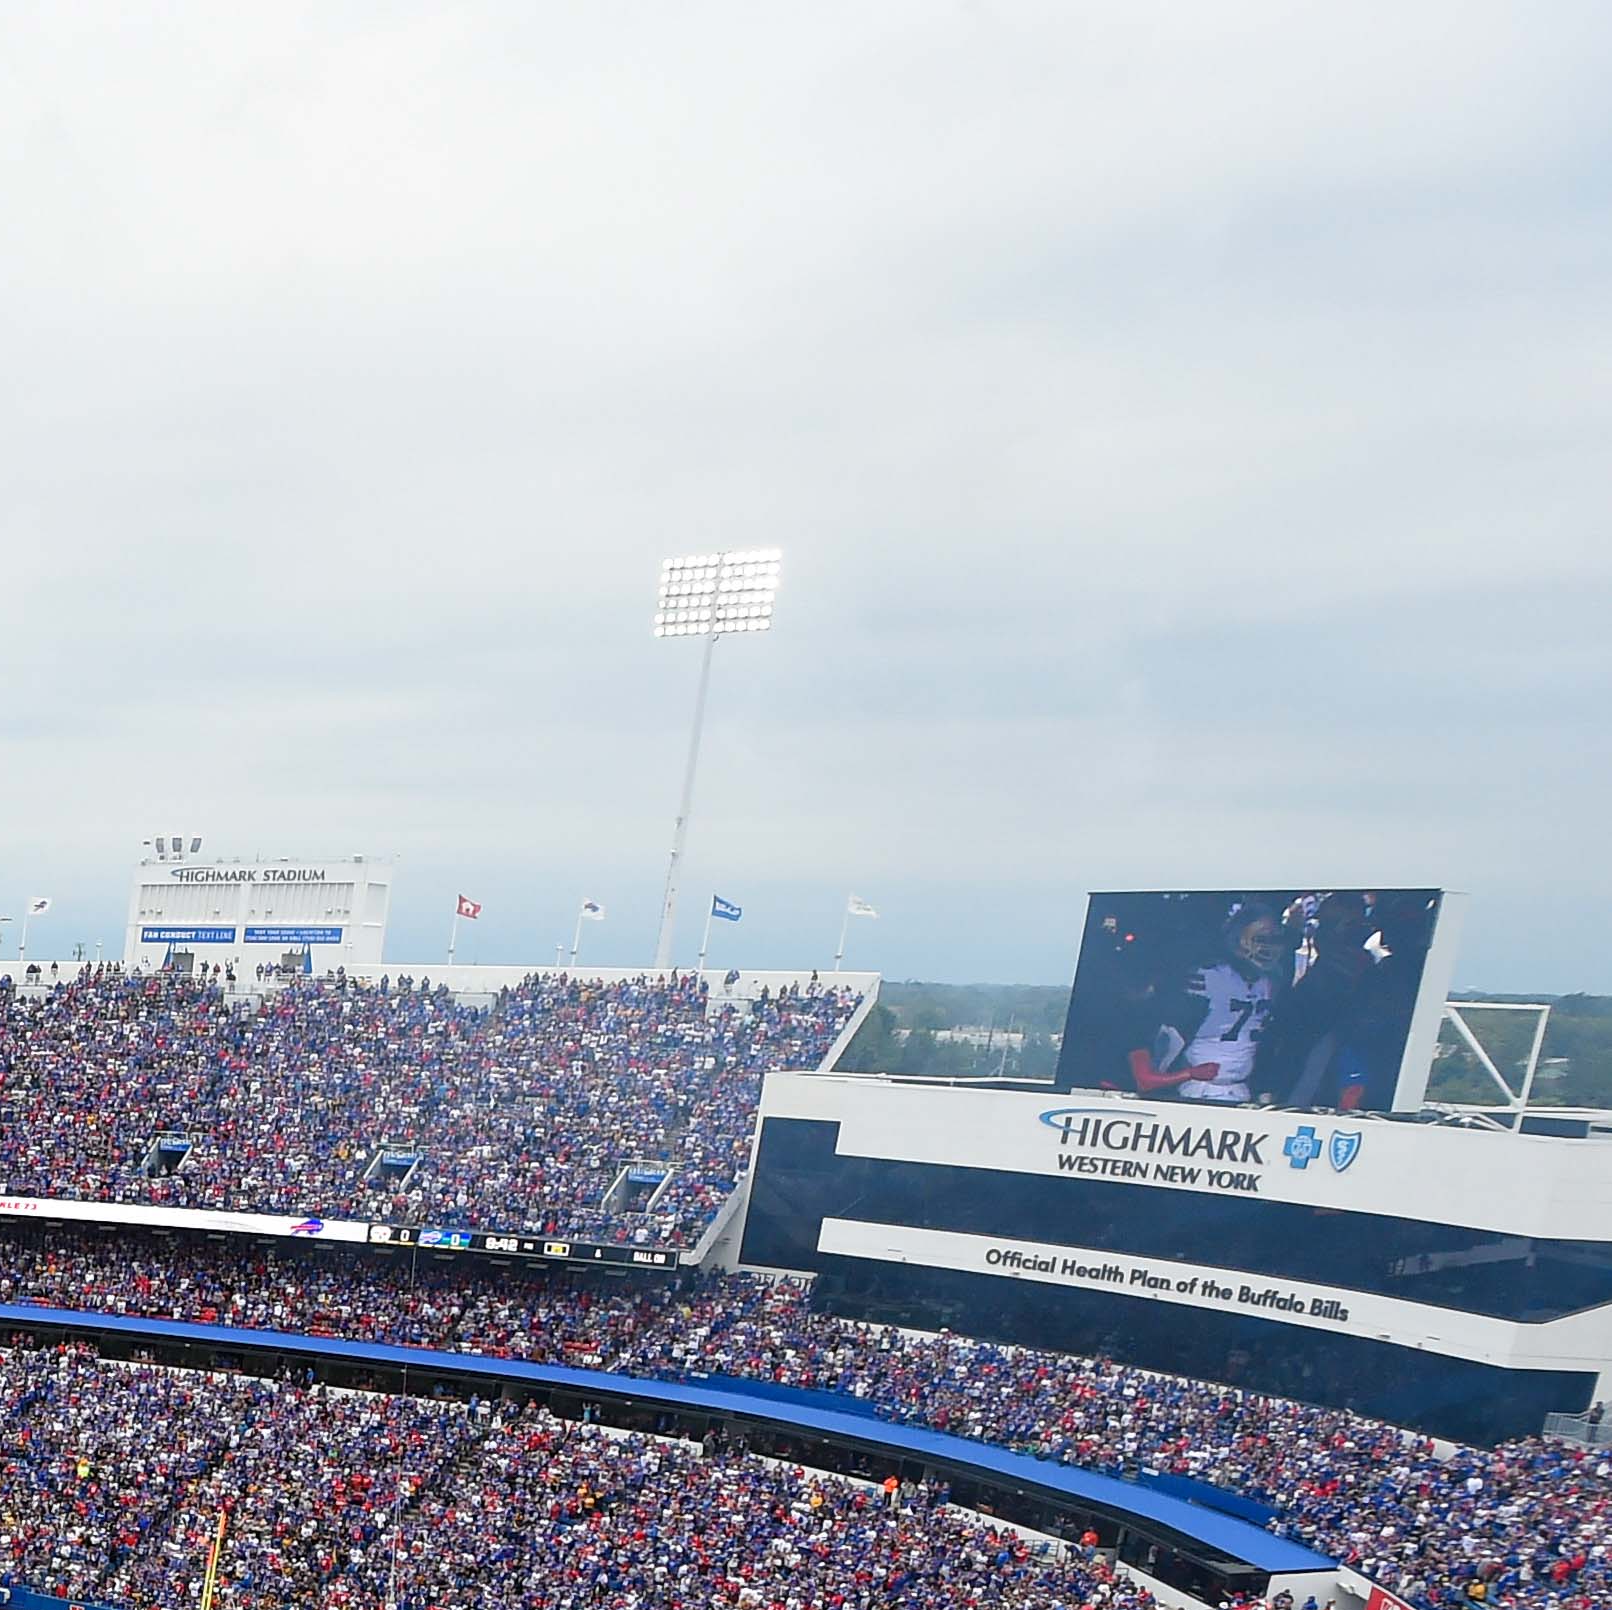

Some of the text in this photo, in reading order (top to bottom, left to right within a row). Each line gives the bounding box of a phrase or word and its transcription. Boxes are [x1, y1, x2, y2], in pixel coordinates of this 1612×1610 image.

[178, 869, 326, 882] HIGHMARK STADIUM
[1059, 1114, 1270, 1166] HIGHMARK
[1057, 1153, 1262, 1192] WESTERN NEW YORK
[400, 1229, 410, 1241] 0
[451, 1233, 461, 1245] 0
[984, 1247, 1350, 1323] Official Health Plan of the Buffalo Bills
